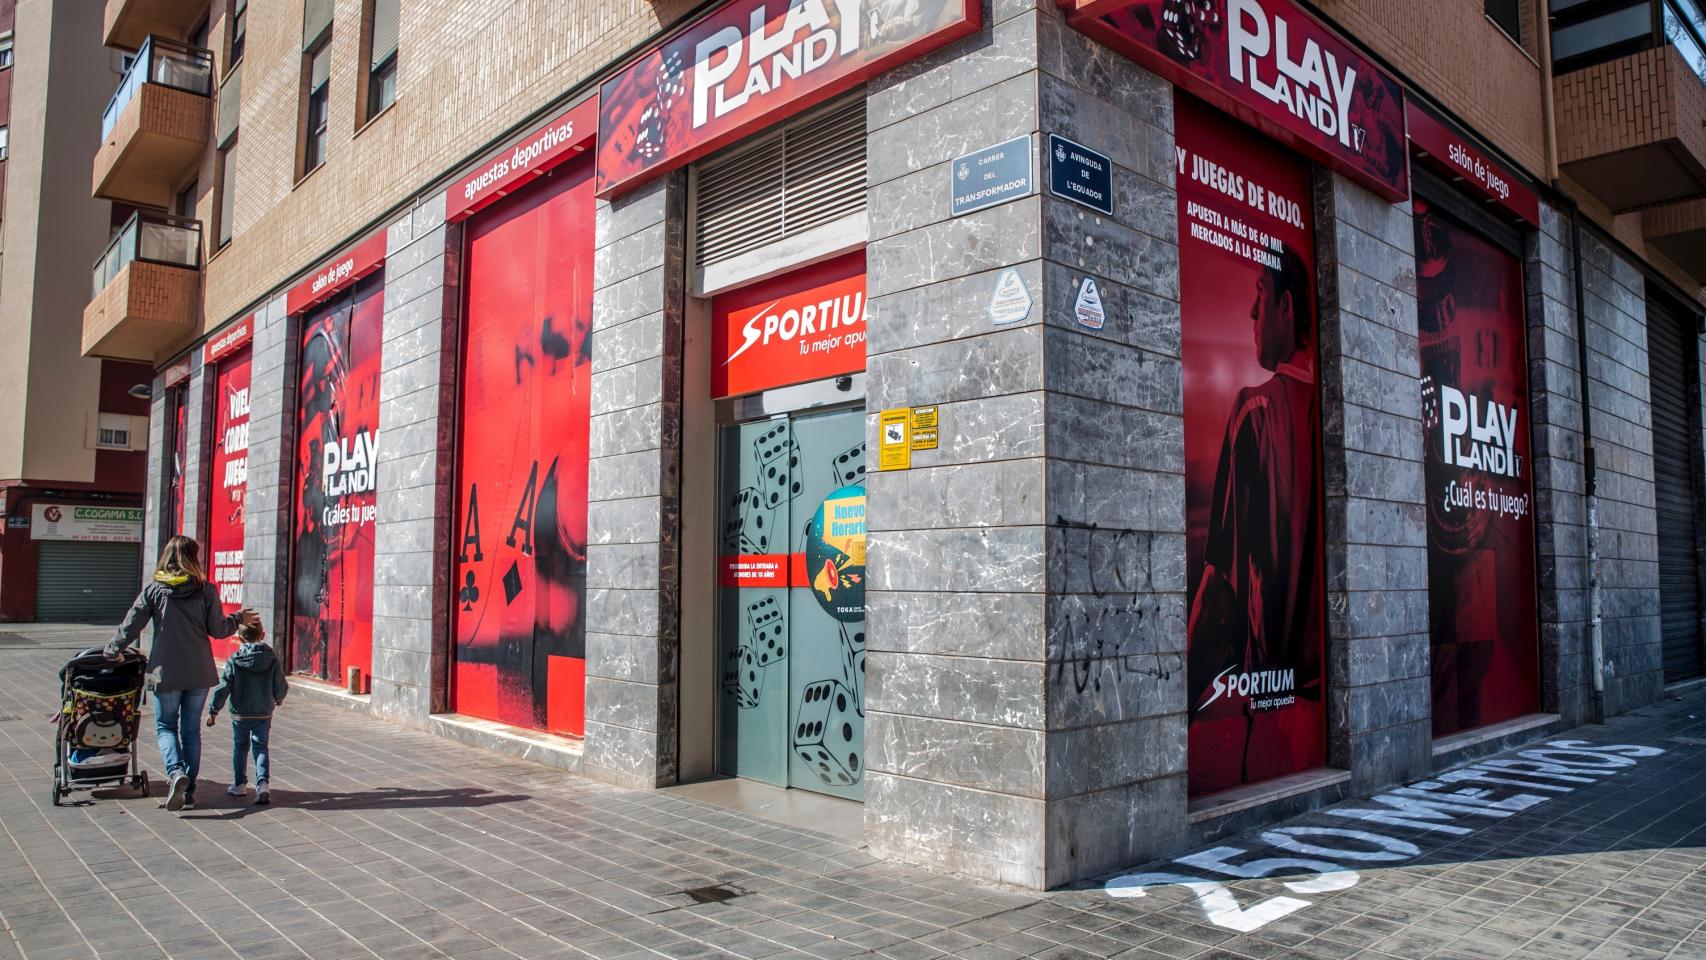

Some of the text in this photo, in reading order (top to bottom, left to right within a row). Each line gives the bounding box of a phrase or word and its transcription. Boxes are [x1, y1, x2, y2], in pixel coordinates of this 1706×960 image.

[693, 0, 863, 129] PLAY
[715, 28, 837, 119] LAND
[1227, 0, 1357, 148] PLAY
[1250, 55, 1337, 137] LAND
[464, 121, 573, 200] apuestas deportivas
[978, 152, 1004, 166] CARRER
[984, 172, 995, 181] DEL
[1070, 152, 1102, 172] AVINGUDA
[1081, 170, 1090, 179] DE
[1449, 144, 1509, 200] salón de juego
[955, 178, 1027, 207] TRANSFORMADOR
[1067, 180, 1103, 201] L'EQUADOR
[1175, 146, 1305, 230] Y JUEGAS DE ROJO.
[1187, 201, 1284, 254] APUESTA A MÁS DE 60 MIL
[1191, 222, 1282, 271] MERCADOS A LA SEMANA
[312, 258, 353, 294] salón de juego
[721, 291, 867, 366] SPORTIU
[800, 332, 867, 355] Tu mejor apu
[230, 388, 249, 420] VUEL
[1441, 385, 1518, 477] PLAY
[322, 429, 379, 496] PLAY
[1456, 437, 1506, 475] LAND
[329, 470, 368, 496] LAND
[1444, 480, 1528, 520] ¿Cuál es tu juego?
[351, 504, 360, 523] tu
[835, 504, 865, 519] Nuevo
[1197, 664, 1295, 711] SPORTIUM
[1250, 695, 1295, 711] Tu mejor apuesta
[1105, 740, 1666, 932] 250 METROS
